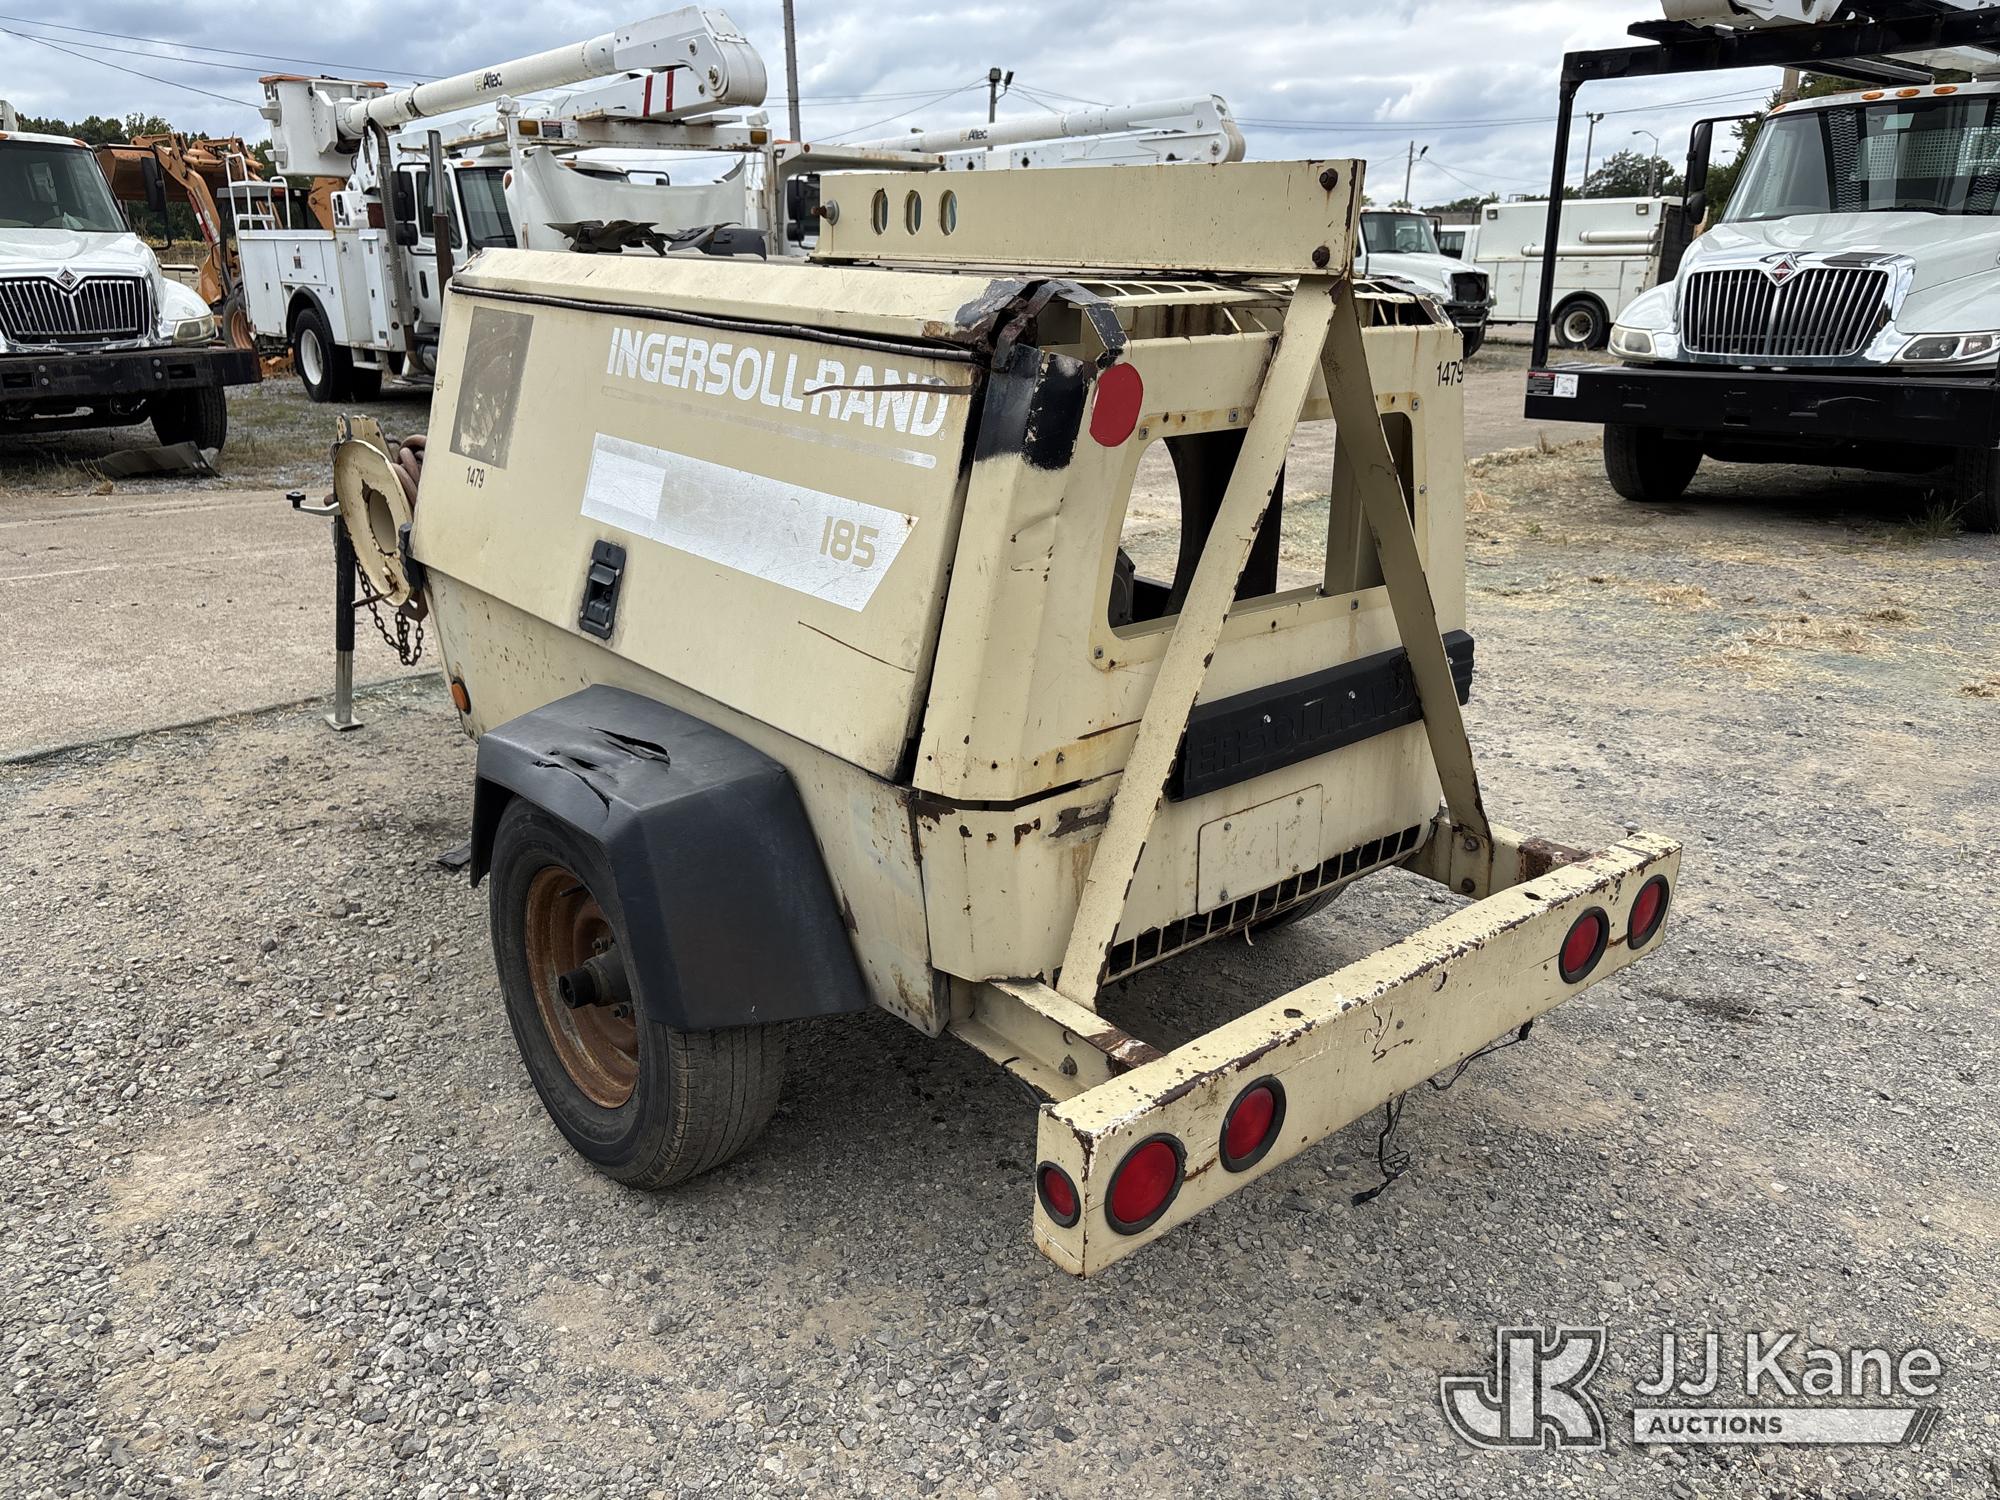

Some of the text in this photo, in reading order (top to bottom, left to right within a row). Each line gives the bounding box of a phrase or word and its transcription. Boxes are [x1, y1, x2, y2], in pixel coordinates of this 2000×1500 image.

[606, 327, 949, 437] INGERSOLL-RAND
[1436, 359, 1464, 387] 1479
[466, 465, 485, 489] 1479
[819, 515, 880, 569] 185
